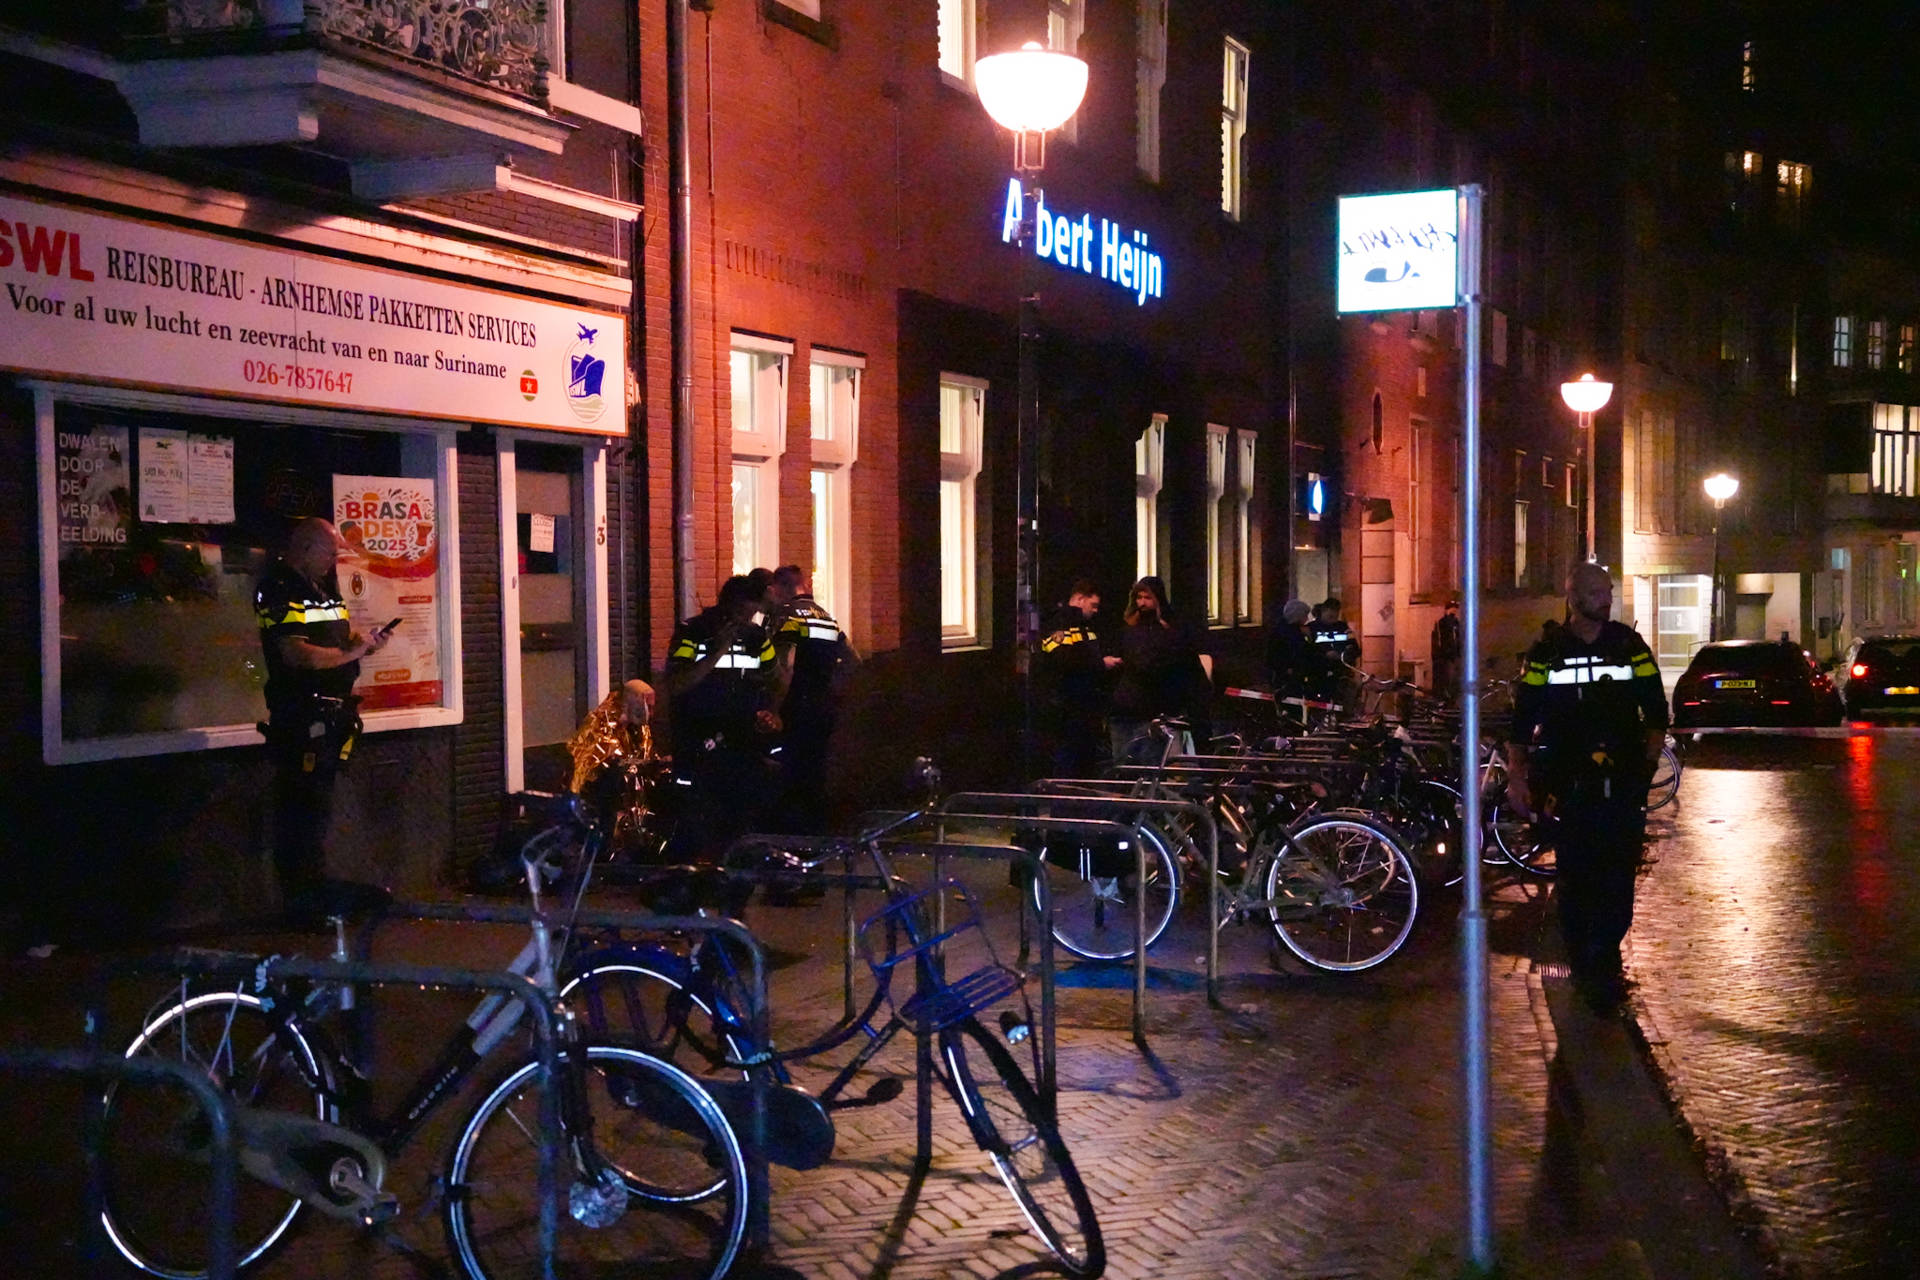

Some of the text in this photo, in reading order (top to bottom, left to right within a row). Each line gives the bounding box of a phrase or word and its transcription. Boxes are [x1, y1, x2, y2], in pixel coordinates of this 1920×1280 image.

[1002, 178, 1162, 306] Abert Heijn
[106, 246, 244, 301] REISBUREAU
[261, 277, 363, 321] ARNHEMSE
[369, 295, 464, 336] PAKKETTEN
[468, 314, 537, 348] SERVICES
[5, 283, 507, 379] Voor al uw lucht en zeevracht van en naar Suriname
[243, 359, 353, 395] 026-7857647
[59, 432, 120, 451] DWALEN
[60, 455, 105, 473] DOOR
[60, 479, 81, 496] DE
[346, 501, 422, 521] BRASA
[61, 527, 127, 543] EELDING
[363, 520, 408, 538] DEY
[596, 525, 604, 546] 3
[367, 538, 408, 552] 2025
